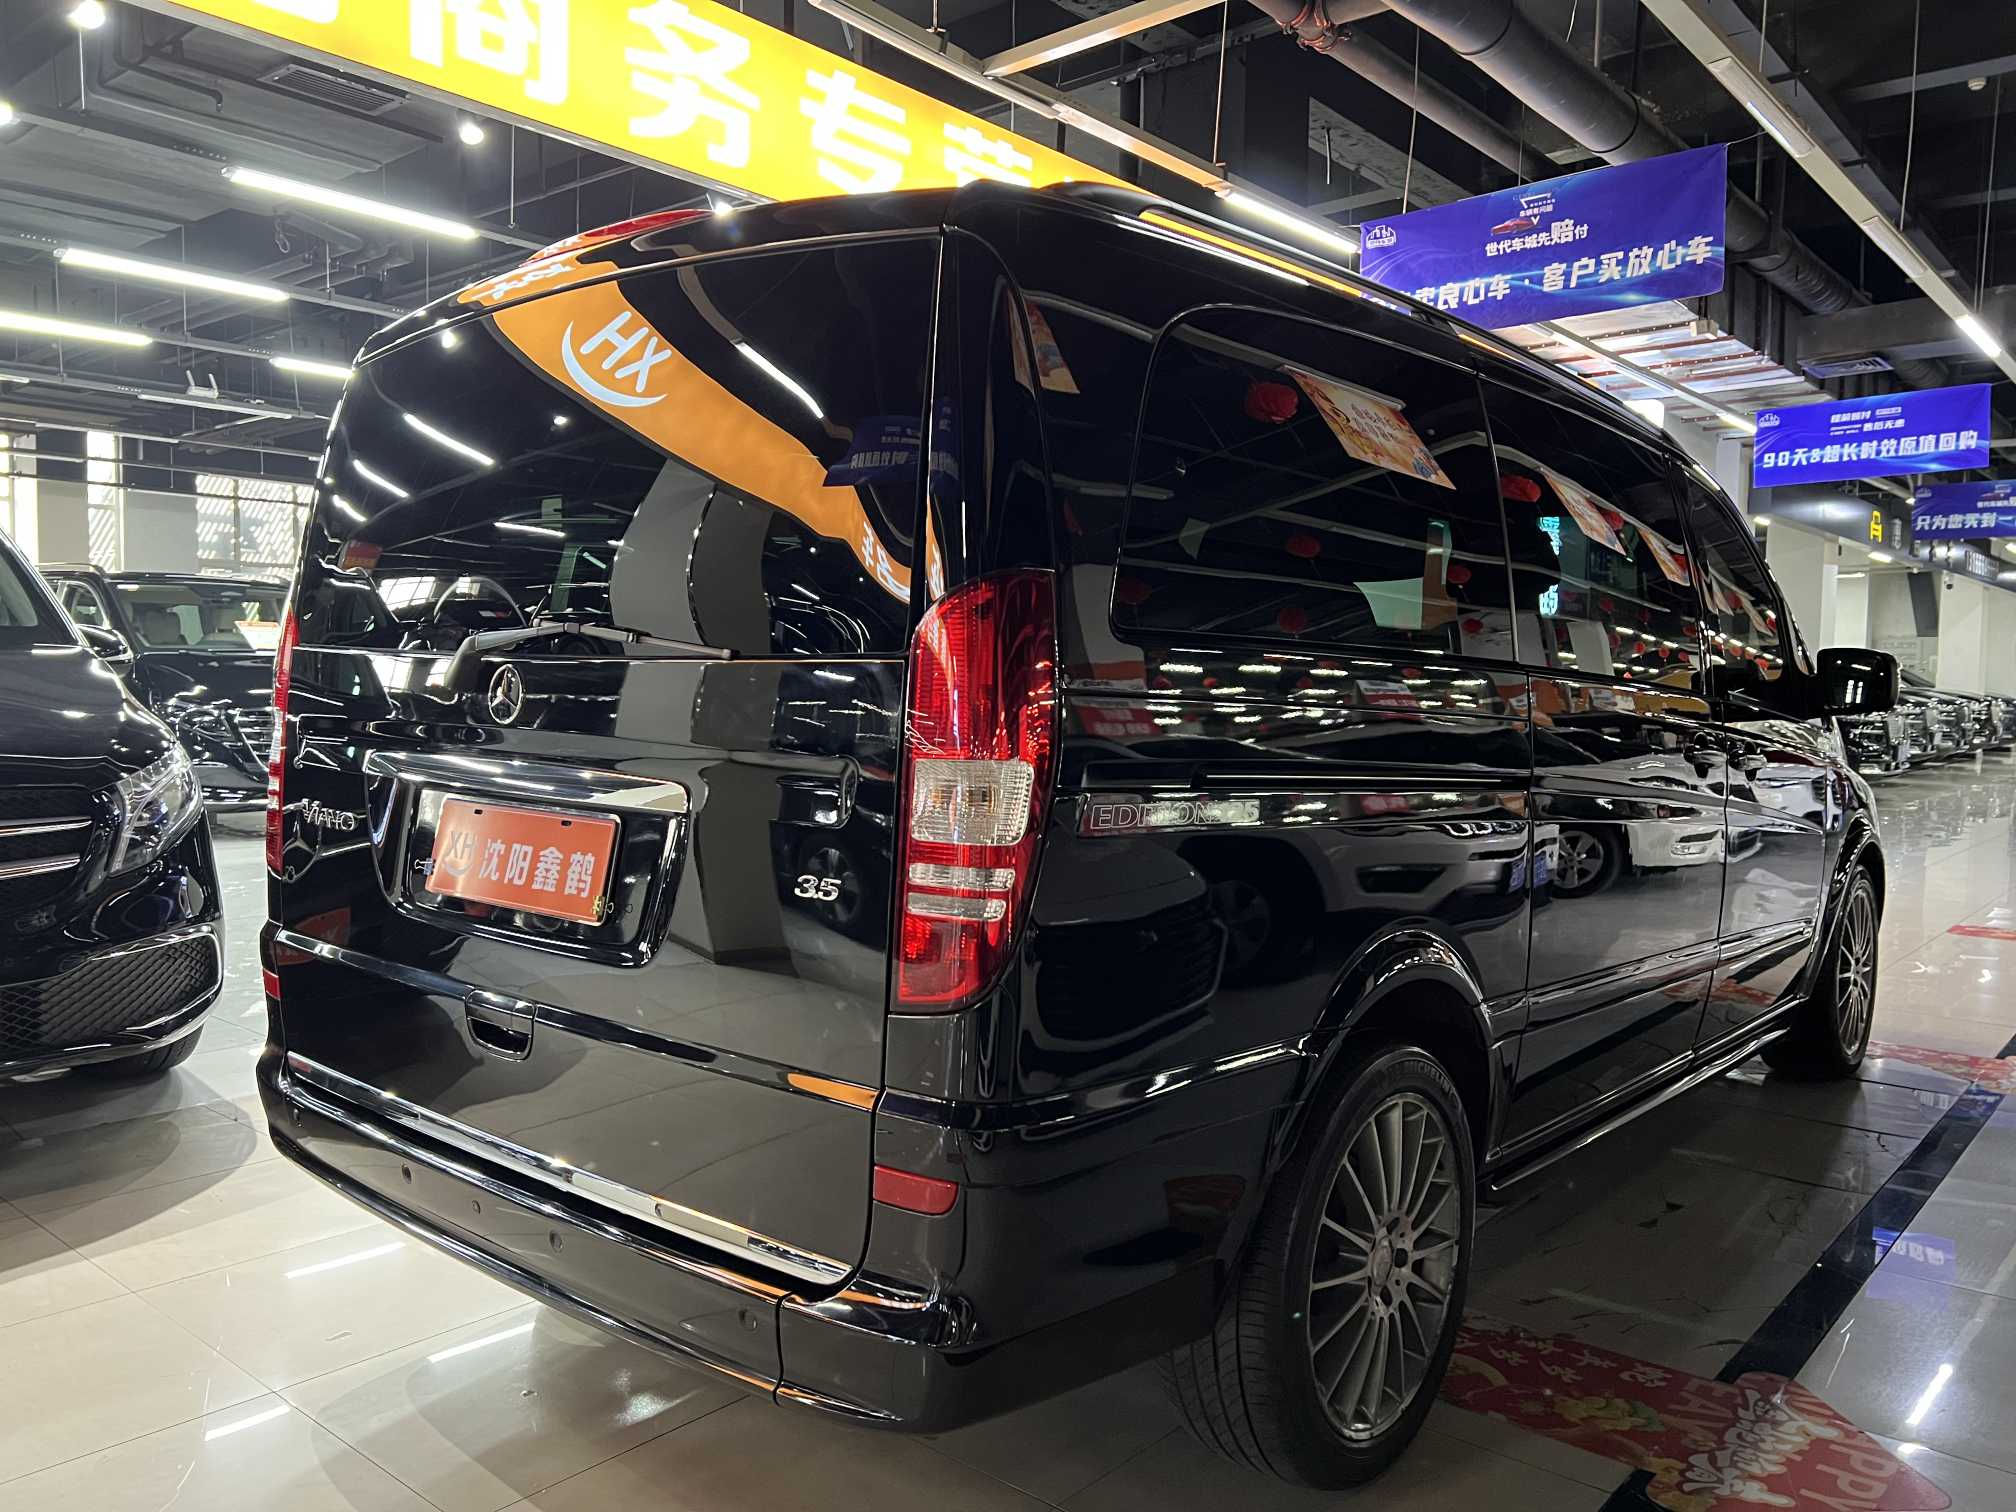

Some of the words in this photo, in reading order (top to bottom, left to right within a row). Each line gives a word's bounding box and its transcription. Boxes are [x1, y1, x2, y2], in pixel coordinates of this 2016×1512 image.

[1485, 218, 1589, 257] 世代车城先赔付
[479, 838, 596, 899] 沈阳鑫鹤
